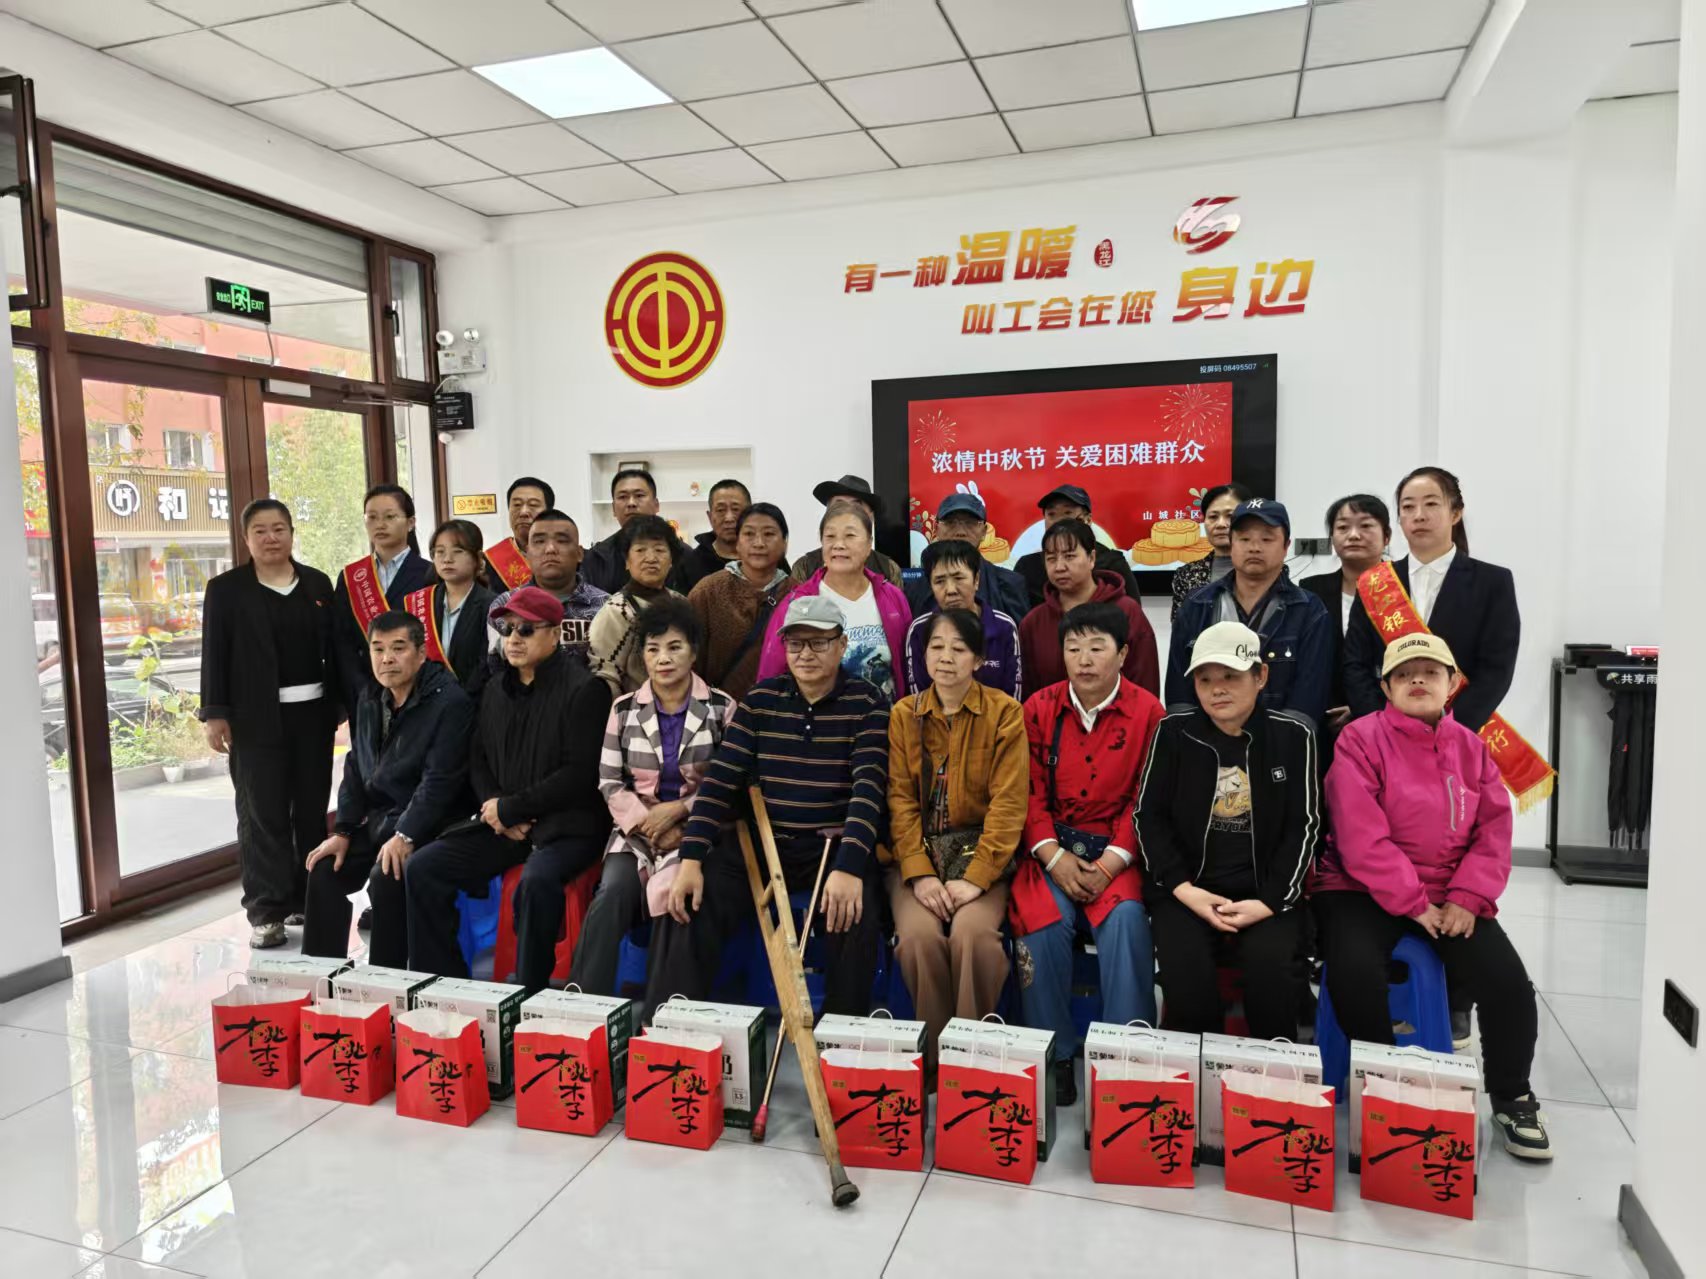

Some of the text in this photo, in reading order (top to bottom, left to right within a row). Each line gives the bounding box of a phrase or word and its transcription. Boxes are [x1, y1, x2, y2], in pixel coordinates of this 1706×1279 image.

[844, 225, 1077, 293] 有一种温暖
[961, 259, 1315, 334] 叫工会在您身边
[251, 300, 264, 311] EXIT
[1223, 363, 1257, 372] 08495507
[932, 439, 1206, 474] 浓情中秋节 关爱困难群众
[1143, 509, 1200, 521] 山城社区
[1397, 640, 1430, 652] COLORADO
